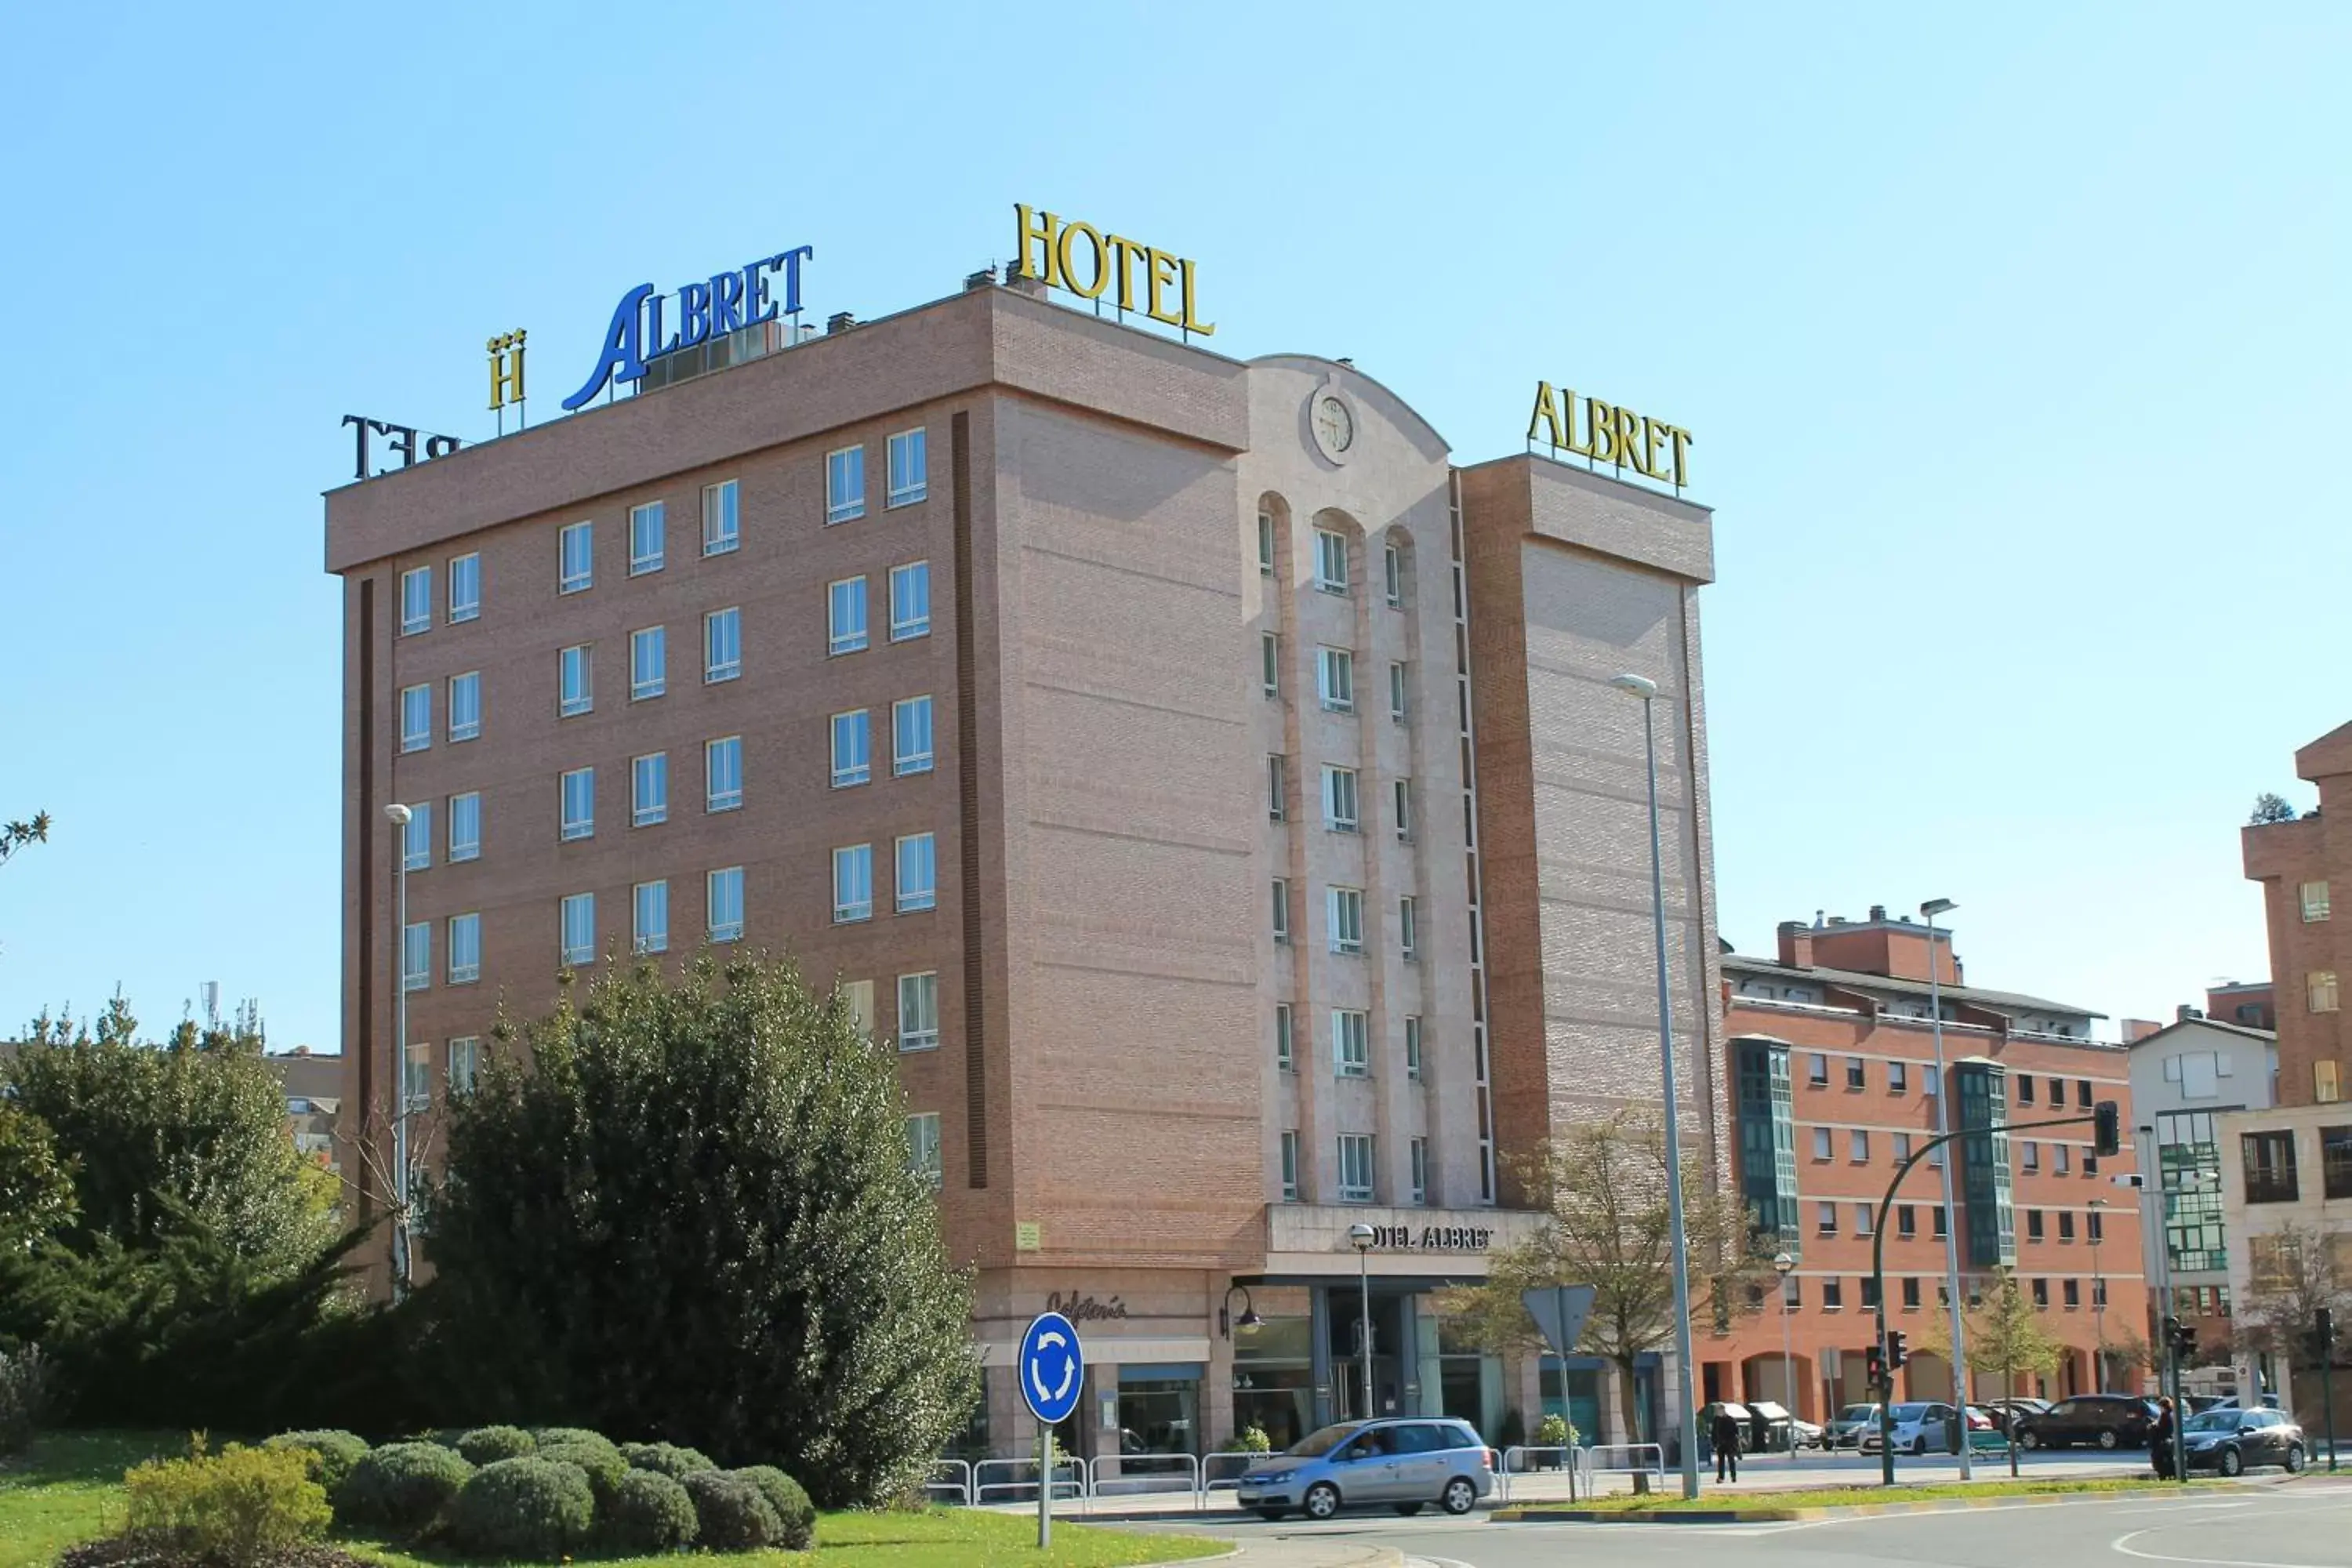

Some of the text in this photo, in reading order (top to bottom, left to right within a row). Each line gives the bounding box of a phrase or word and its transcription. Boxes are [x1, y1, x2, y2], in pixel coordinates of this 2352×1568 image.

[561, 245, 813, 411] ALBRET
[1014, 203, 1216, 336] HOTEL
[1528, 380, 1693, 487] ALBRET
[1367, 1225, 1494, 1249] OTEL ALBRET
